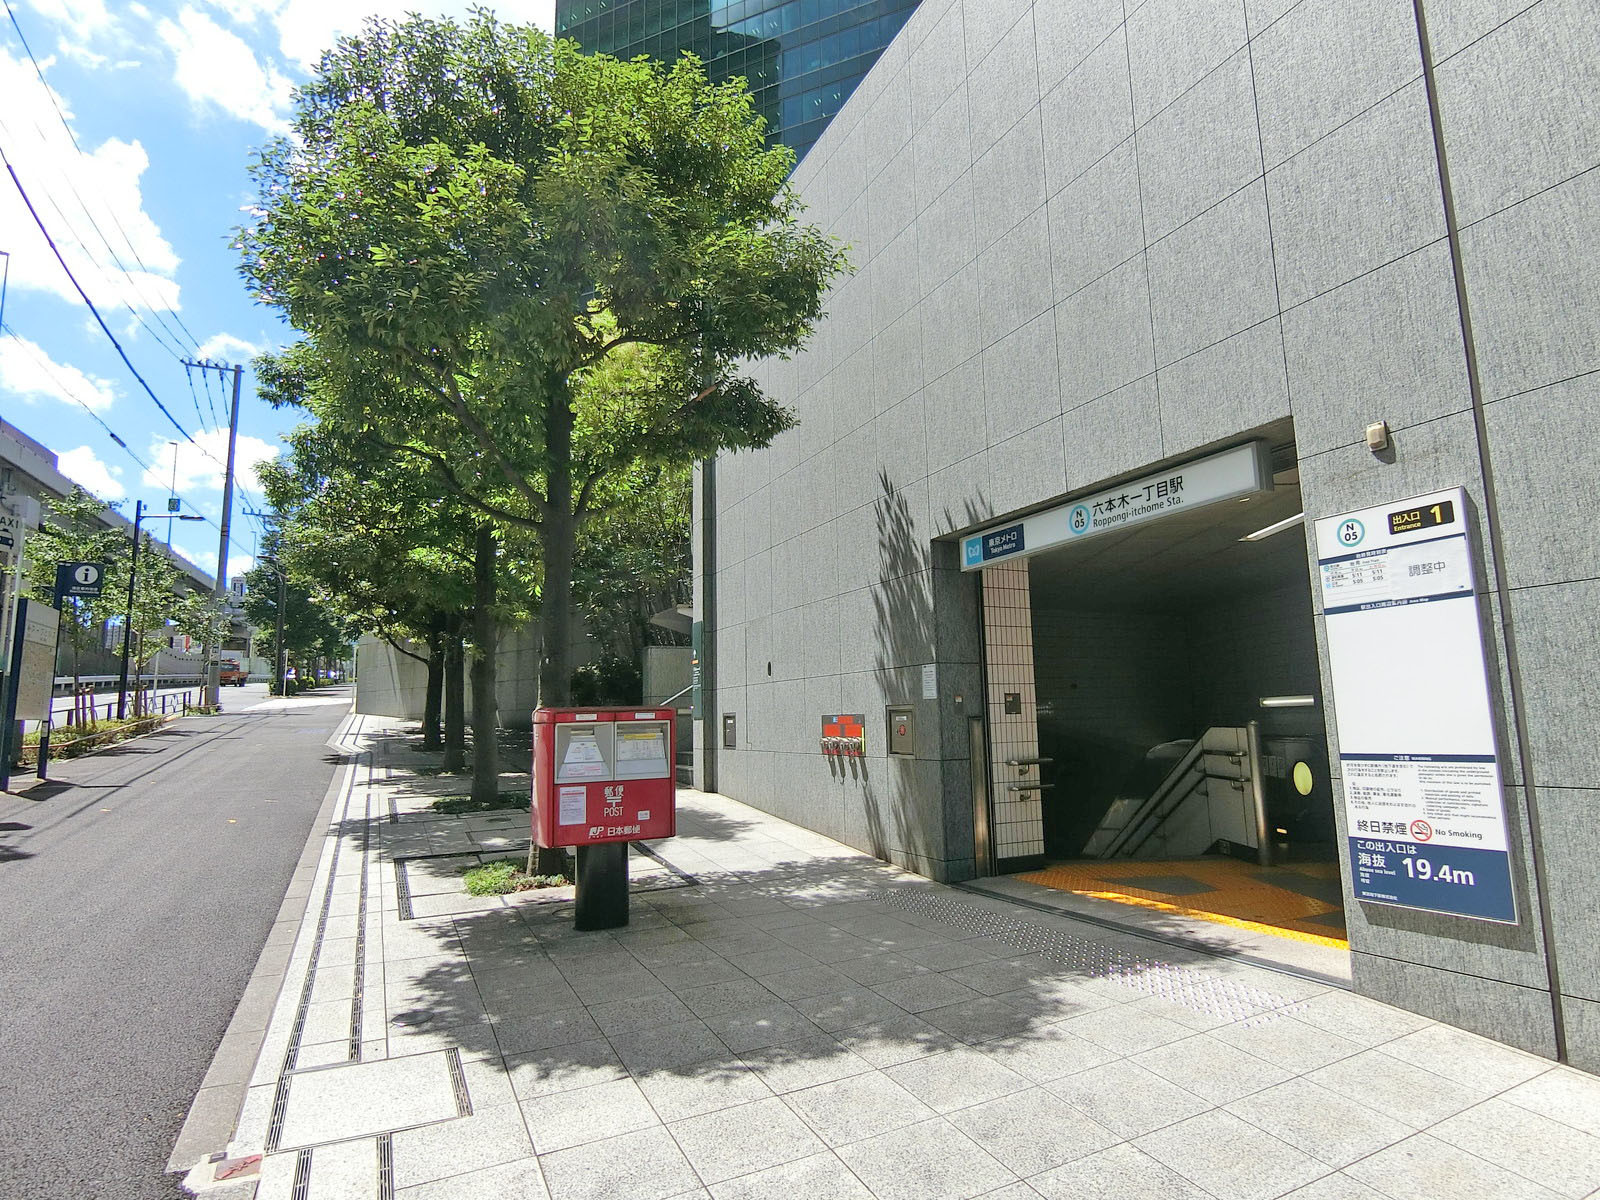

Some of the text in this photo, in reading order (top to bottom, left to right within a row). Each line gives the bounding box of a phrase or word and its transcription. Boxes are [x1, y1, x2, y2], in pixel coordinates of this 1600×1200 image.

[1092, 475, 1184, 517] 六本木一丁目駅
[1076, 509, 1083, 518] N
[1092, 496, 1184, 528] Roppongi-itchome Sta.
[1392, 511, 1420, 525] 出入口
[1429, 505, 1442, 523] 1
[0, 516, 19, 529] AXI
[1074, 519, 1085, 529] 05
[1346, 523, 1355, 532] N
[1393, 522, 1421, 532] Entrance
[989, 531, 1017, 548] 東京メトロ
[1344, 531, 1358, 542] 05
[1408, 561, 1445, 577] 調整中
[604, 785, 624, 797] 郵便
[604, 807, 623, 817] POST
[607, 825, 641, 836] 日本郵便
[1357, 819, 1407, 836] 終日禁煙
[1449, 830, 1483, 840] Smoking
[1357, 840, 1417, 855] この出入口は
[1358, 852, 1386, 868] 海抜
[1402, 857, 1475, 886] 19.4m
